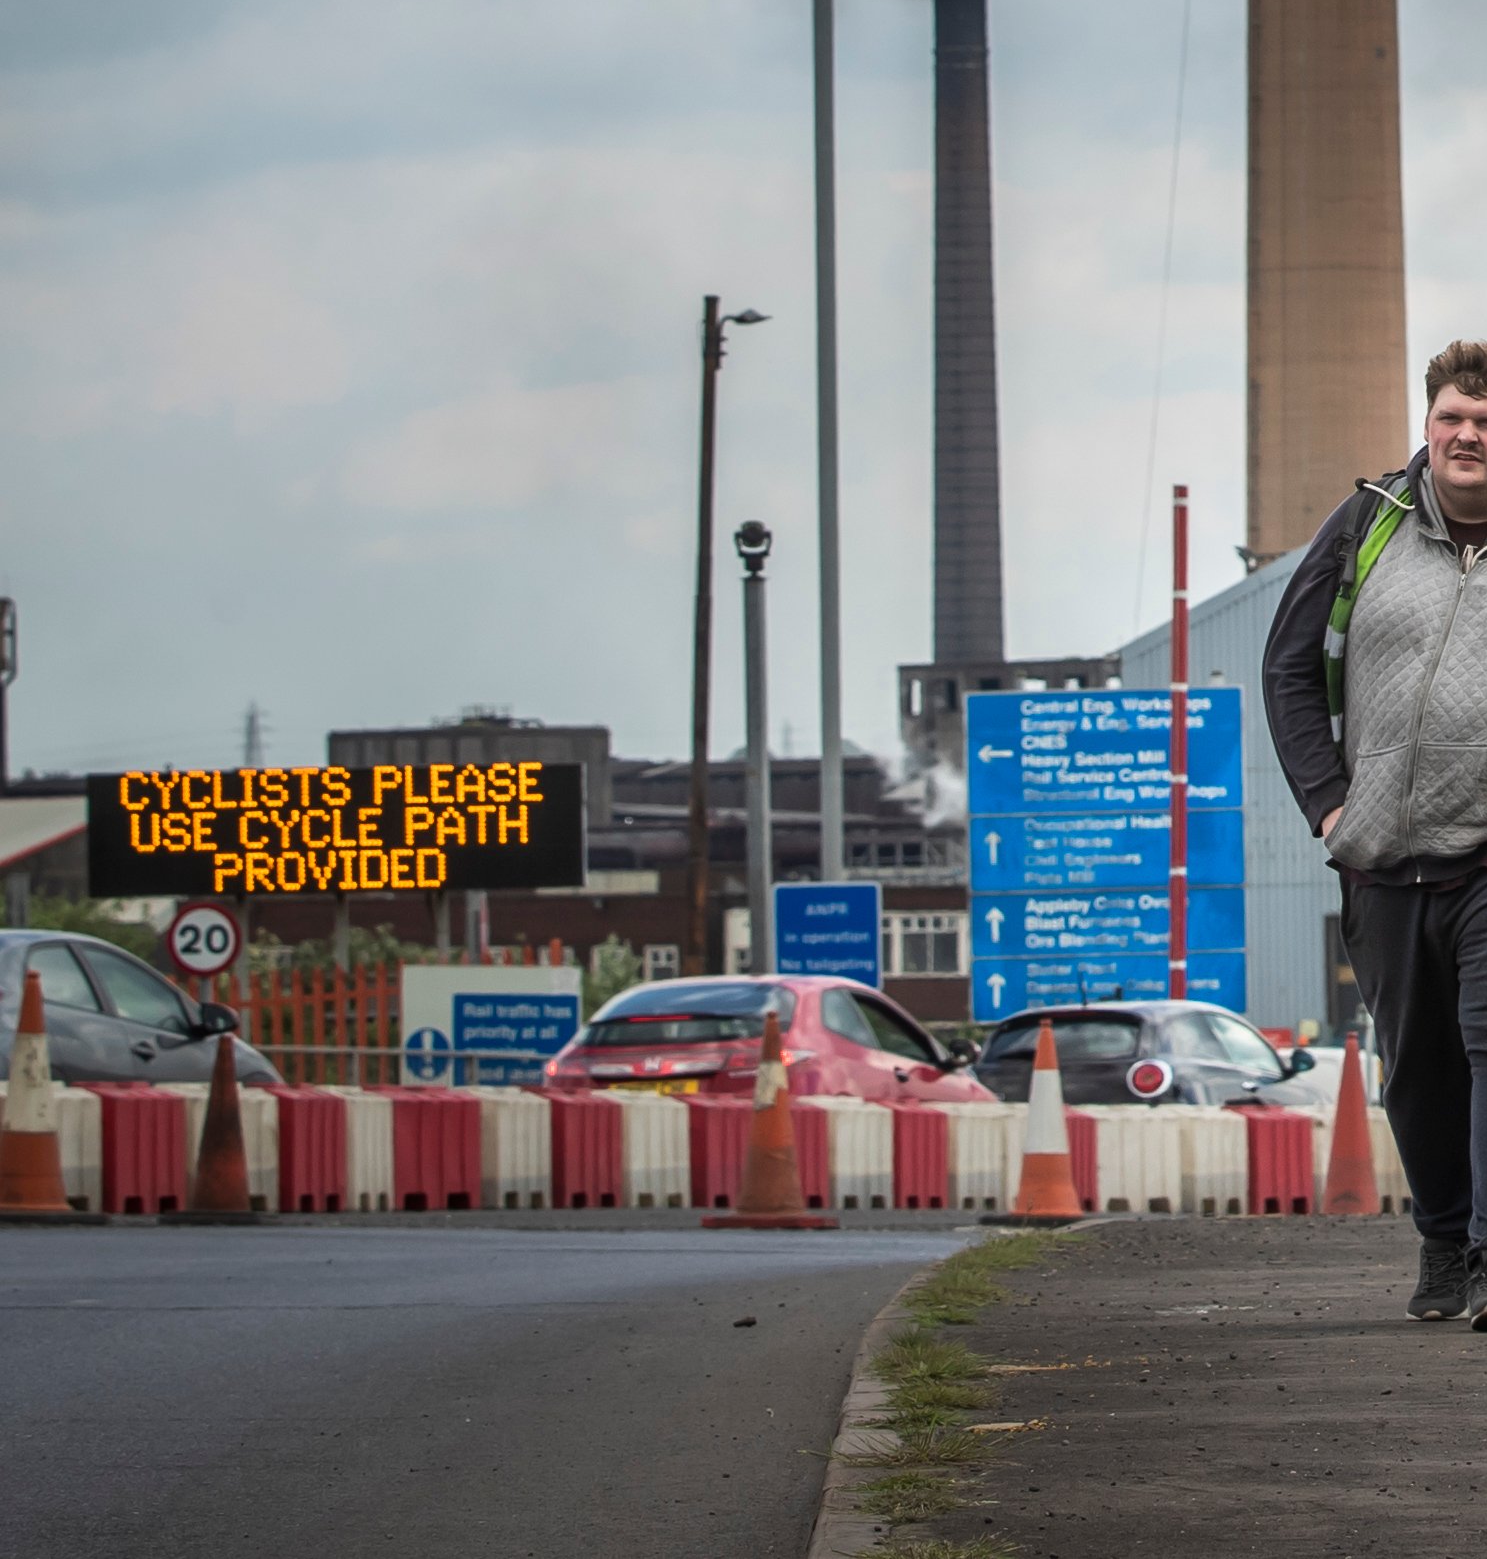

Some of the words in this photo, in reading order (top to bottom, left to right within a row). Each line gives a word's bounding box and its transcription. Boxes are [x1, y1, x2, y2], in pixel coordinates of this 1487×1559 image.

[1020, 699, 1078, 715] Central
[1121, 697, 1212, 713] Worksops
[1021, 717, 1076, 734] Energy
[1081, 716, 1092, 731] &
[1136, 715, 1204, 730] Serves
[1021, 753, 1071, 770] Heavy
[1075, 751, 1134, 767] Section
[1137, 749, 1166, 765] Mill
[120, 767, 351, 810] CYCLISTS
[373, 762, 543, 805] PLEASE
[1056, 769, 1115, 784] Service
[1138, 784, 1227, 800] Worhops
[131, 812, 217, 852] USE
[239, 808, 382, 849] CYCLE
[405, 805, 528, 846] PATH
[1024, 816, 1127, 833] Occupational
[1130, 814, 1172, 829] Healt
[214, 848, 446, 892] PROVIDED
[1025, 897, 1090, 915] Appleby
[1093, 895, 1135, 911] Coke
[1025, 915, 1065, 931] Blast
[1068, 913, 1140, 929] Furnaces
[179, 924, 229, 954] 20
[1025, 932, 1055, 949] Ore
[1059, 932, 1128, 948] Blending
[463, 1002, 493, 1018] Rail
[496, 1003, 541, 1019] traffic
[543, 1003, 573, 1019] has
[463, 1025, 518, 1043] priority
[521, 1026, 536, 1040] at
[539, 1025, 559, 1040] all
